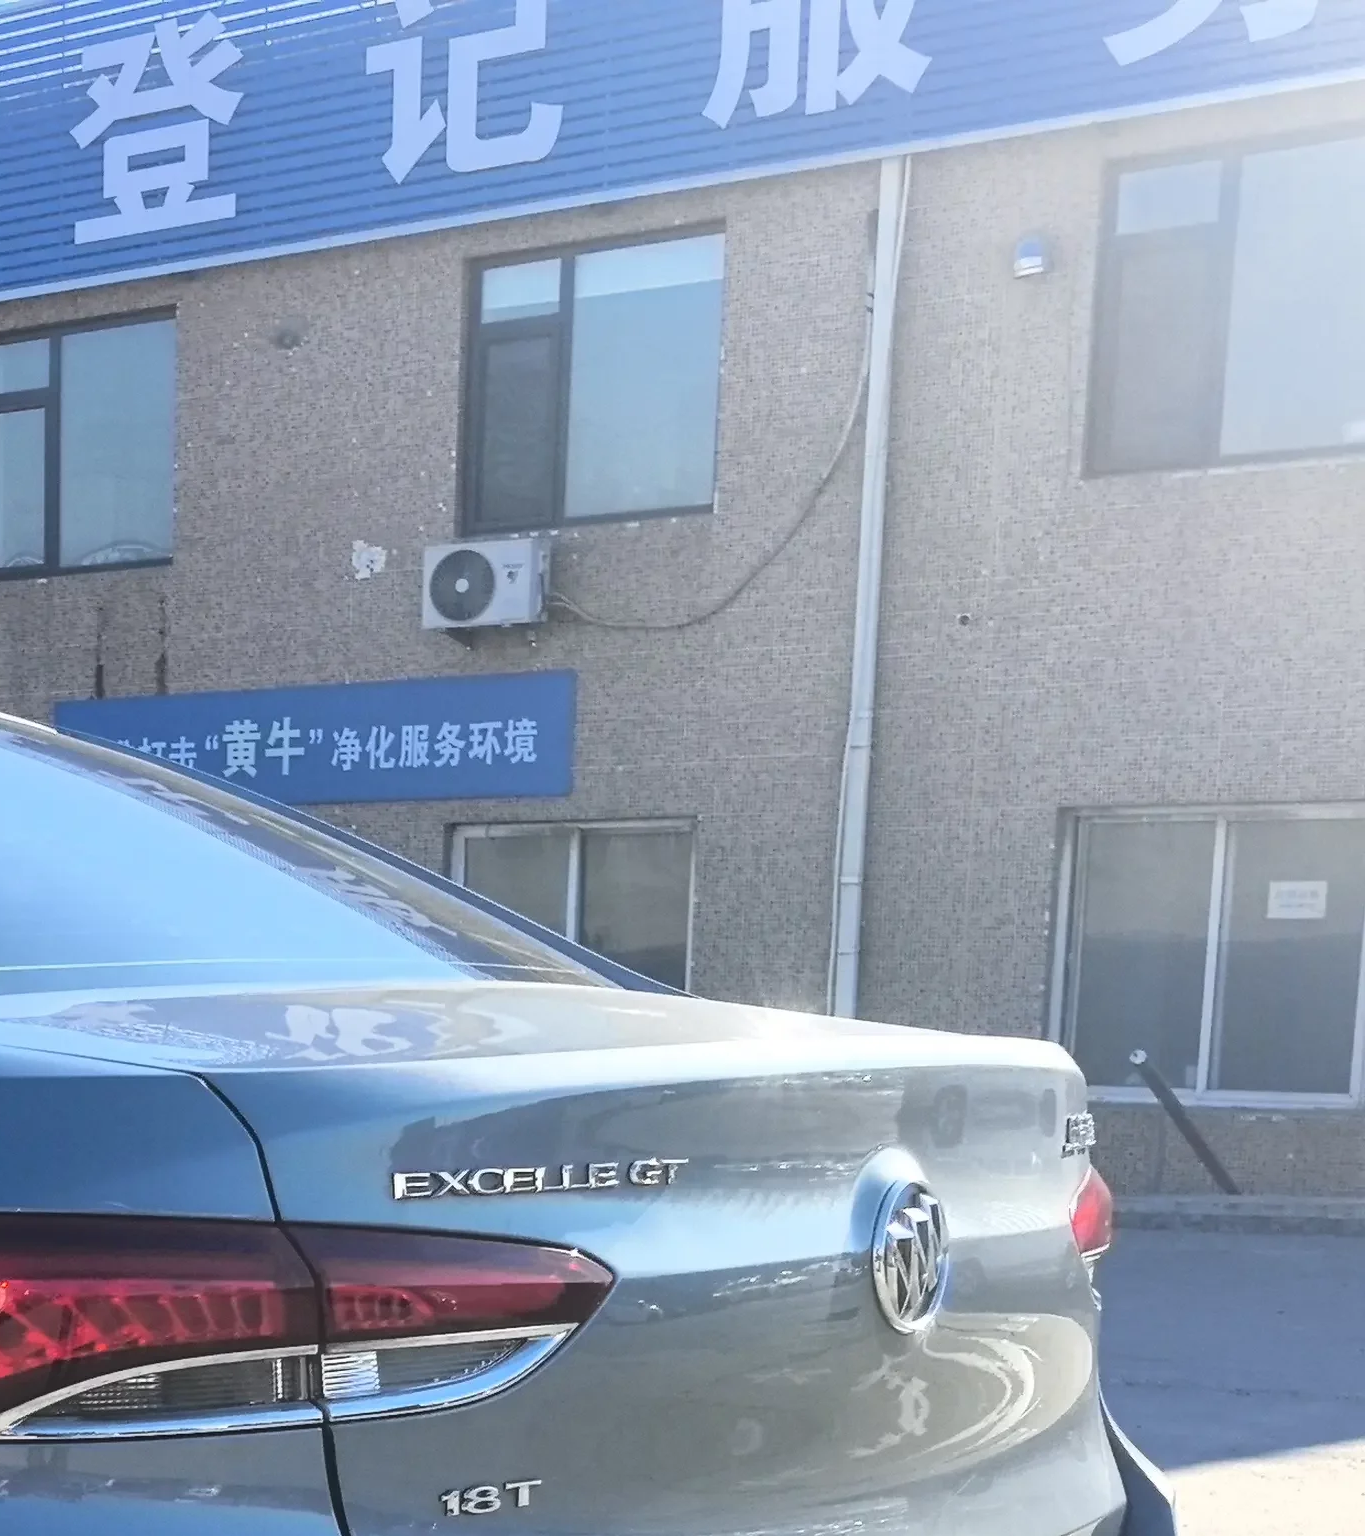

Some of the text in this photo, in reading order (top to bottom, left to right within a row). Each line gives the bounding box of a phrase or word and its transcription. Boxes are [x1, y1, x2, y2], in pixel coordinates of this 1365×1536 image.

[392, 1157, 690, 1200] EXCELLE GT
[439, 1479, 543, 1517] 18T
